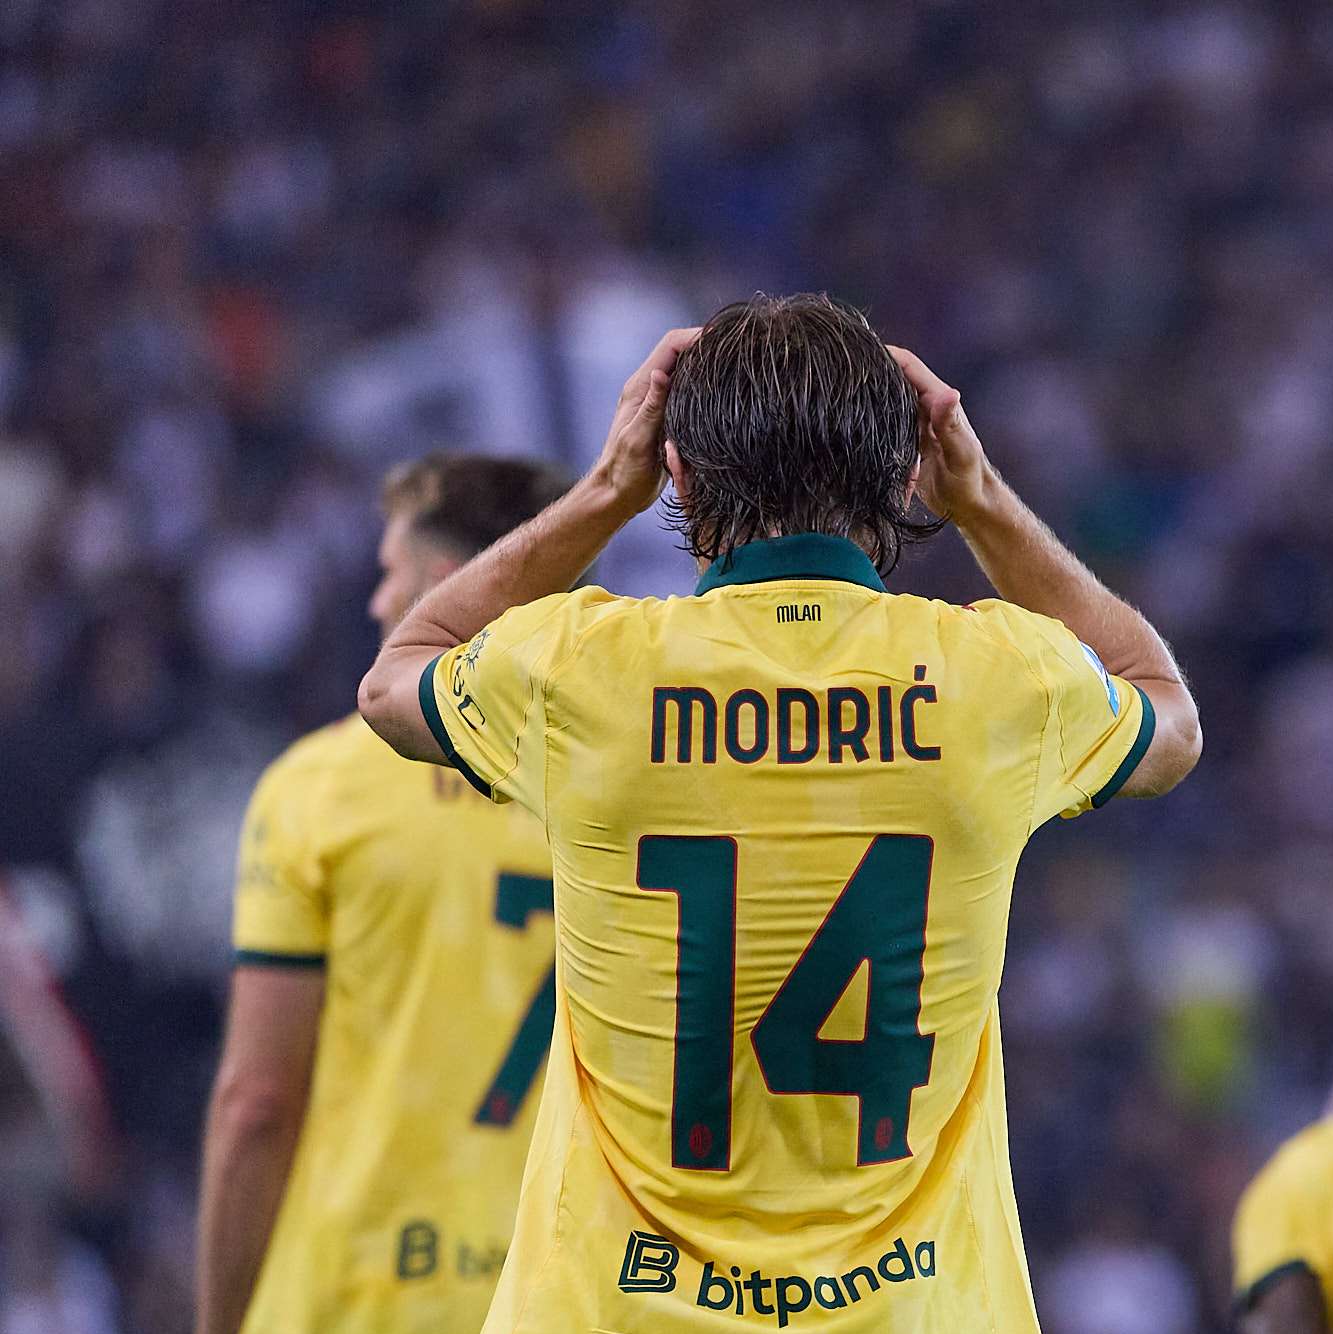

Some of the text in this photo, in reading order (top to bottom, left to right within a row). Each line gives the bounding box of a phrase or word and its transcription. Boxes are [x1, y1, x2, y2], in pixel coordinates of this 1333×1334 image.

[776, 603, 822, 624] MILAN
[650, 664, 942, 765] MODRIĆ
[634, 833, 937, 1172] 14
[696, 1237, 937, 1329] bitpanda
